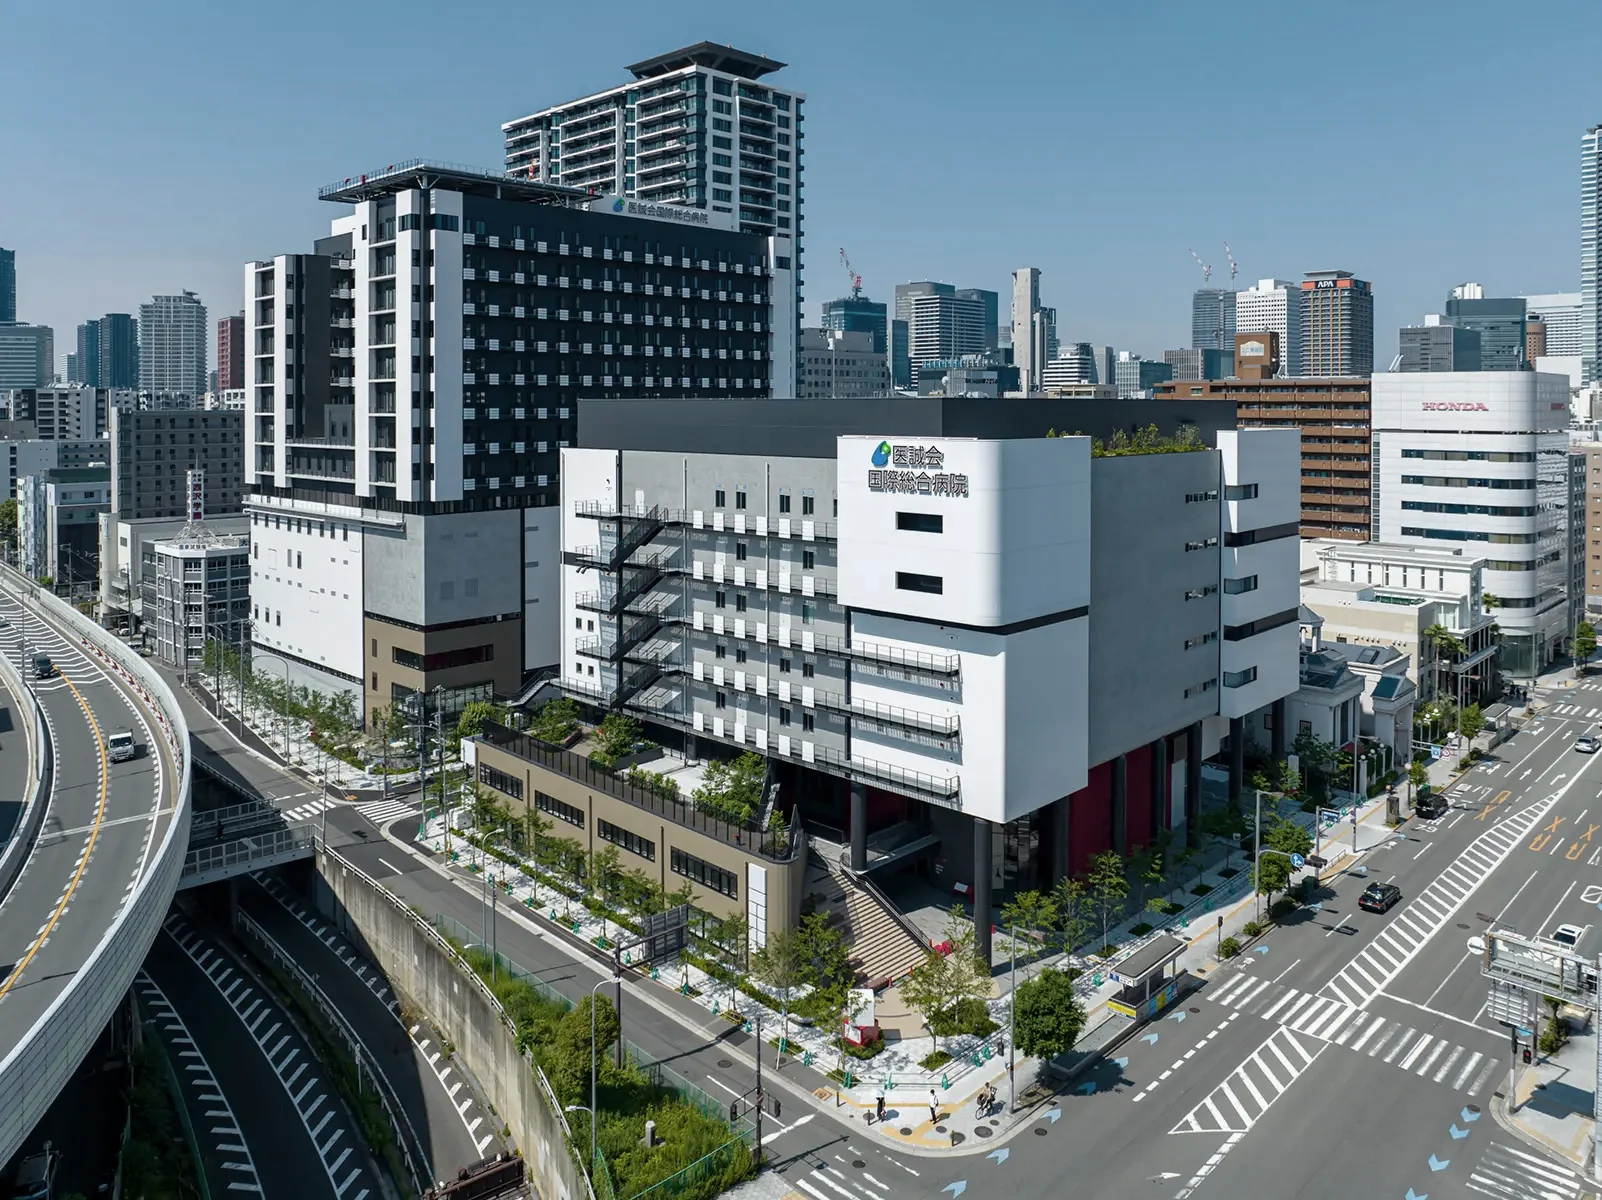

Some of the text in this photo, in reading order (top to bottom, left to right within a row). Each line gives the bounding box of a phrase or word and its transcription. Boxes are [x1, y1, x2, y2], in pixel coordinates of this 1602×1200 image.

[628, 201, 709, 224] 医誠会国際総合病院
[1317, 280, 1334, 288] APA
[1422, 401, 1489, 411] HONDA
[893, 445, 943, 466] 医誠会
[868, 469, 967, 494] 国際総合病院
